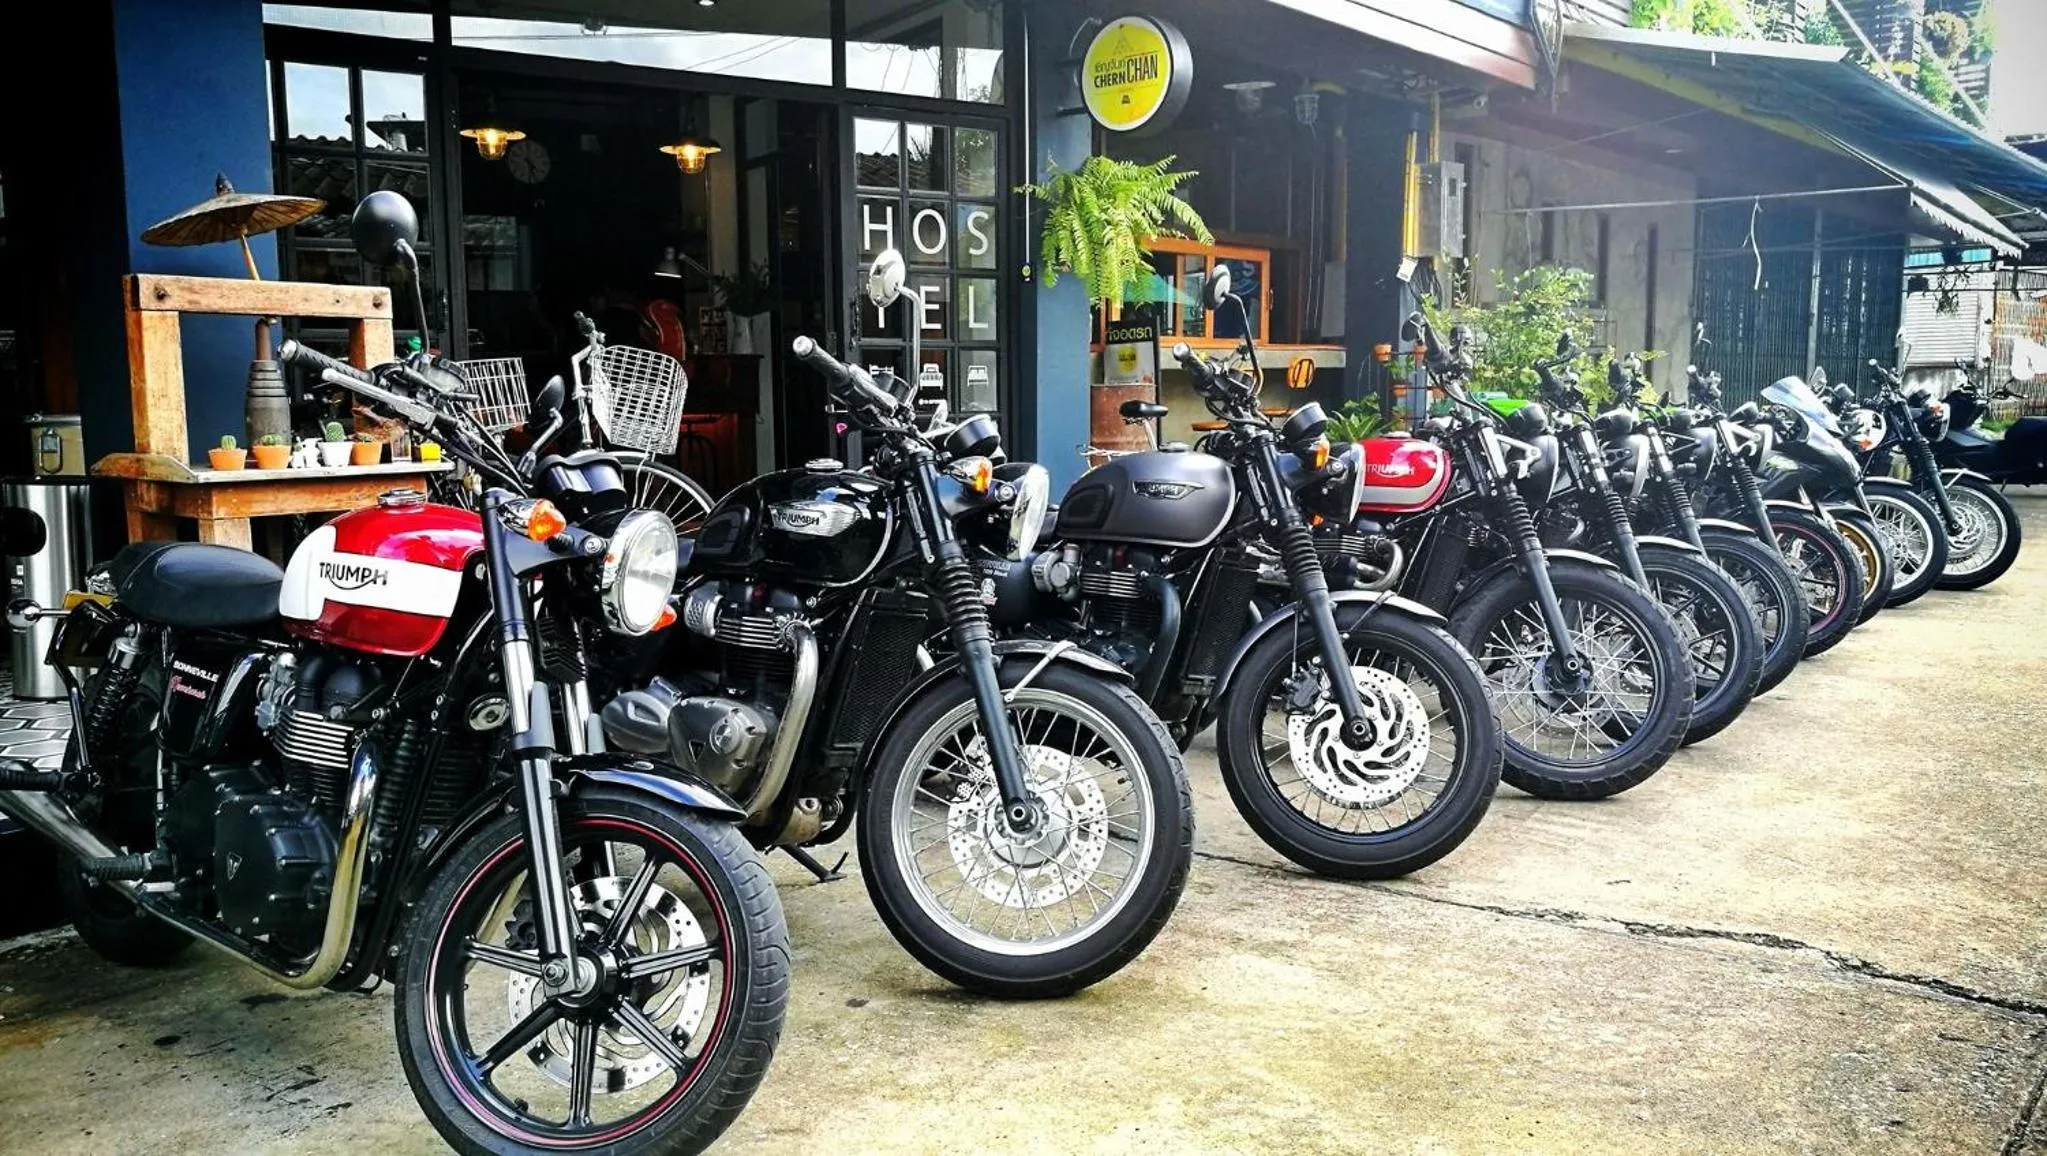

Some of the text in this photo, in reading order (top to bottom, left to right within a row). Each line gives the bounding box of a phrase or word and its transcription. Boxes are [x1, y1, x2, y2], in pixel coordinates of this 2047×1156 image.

[1094, 71, 1126, 88] CHERN
[1127, 54, 1158, 83] CHAN
[863, 204, 989, 255] HOS
[868, 284, 989, 330] EL
[1366, 463, 1416, 477] TRIUH
[319, 561, 389, 588] TRIUMPH
